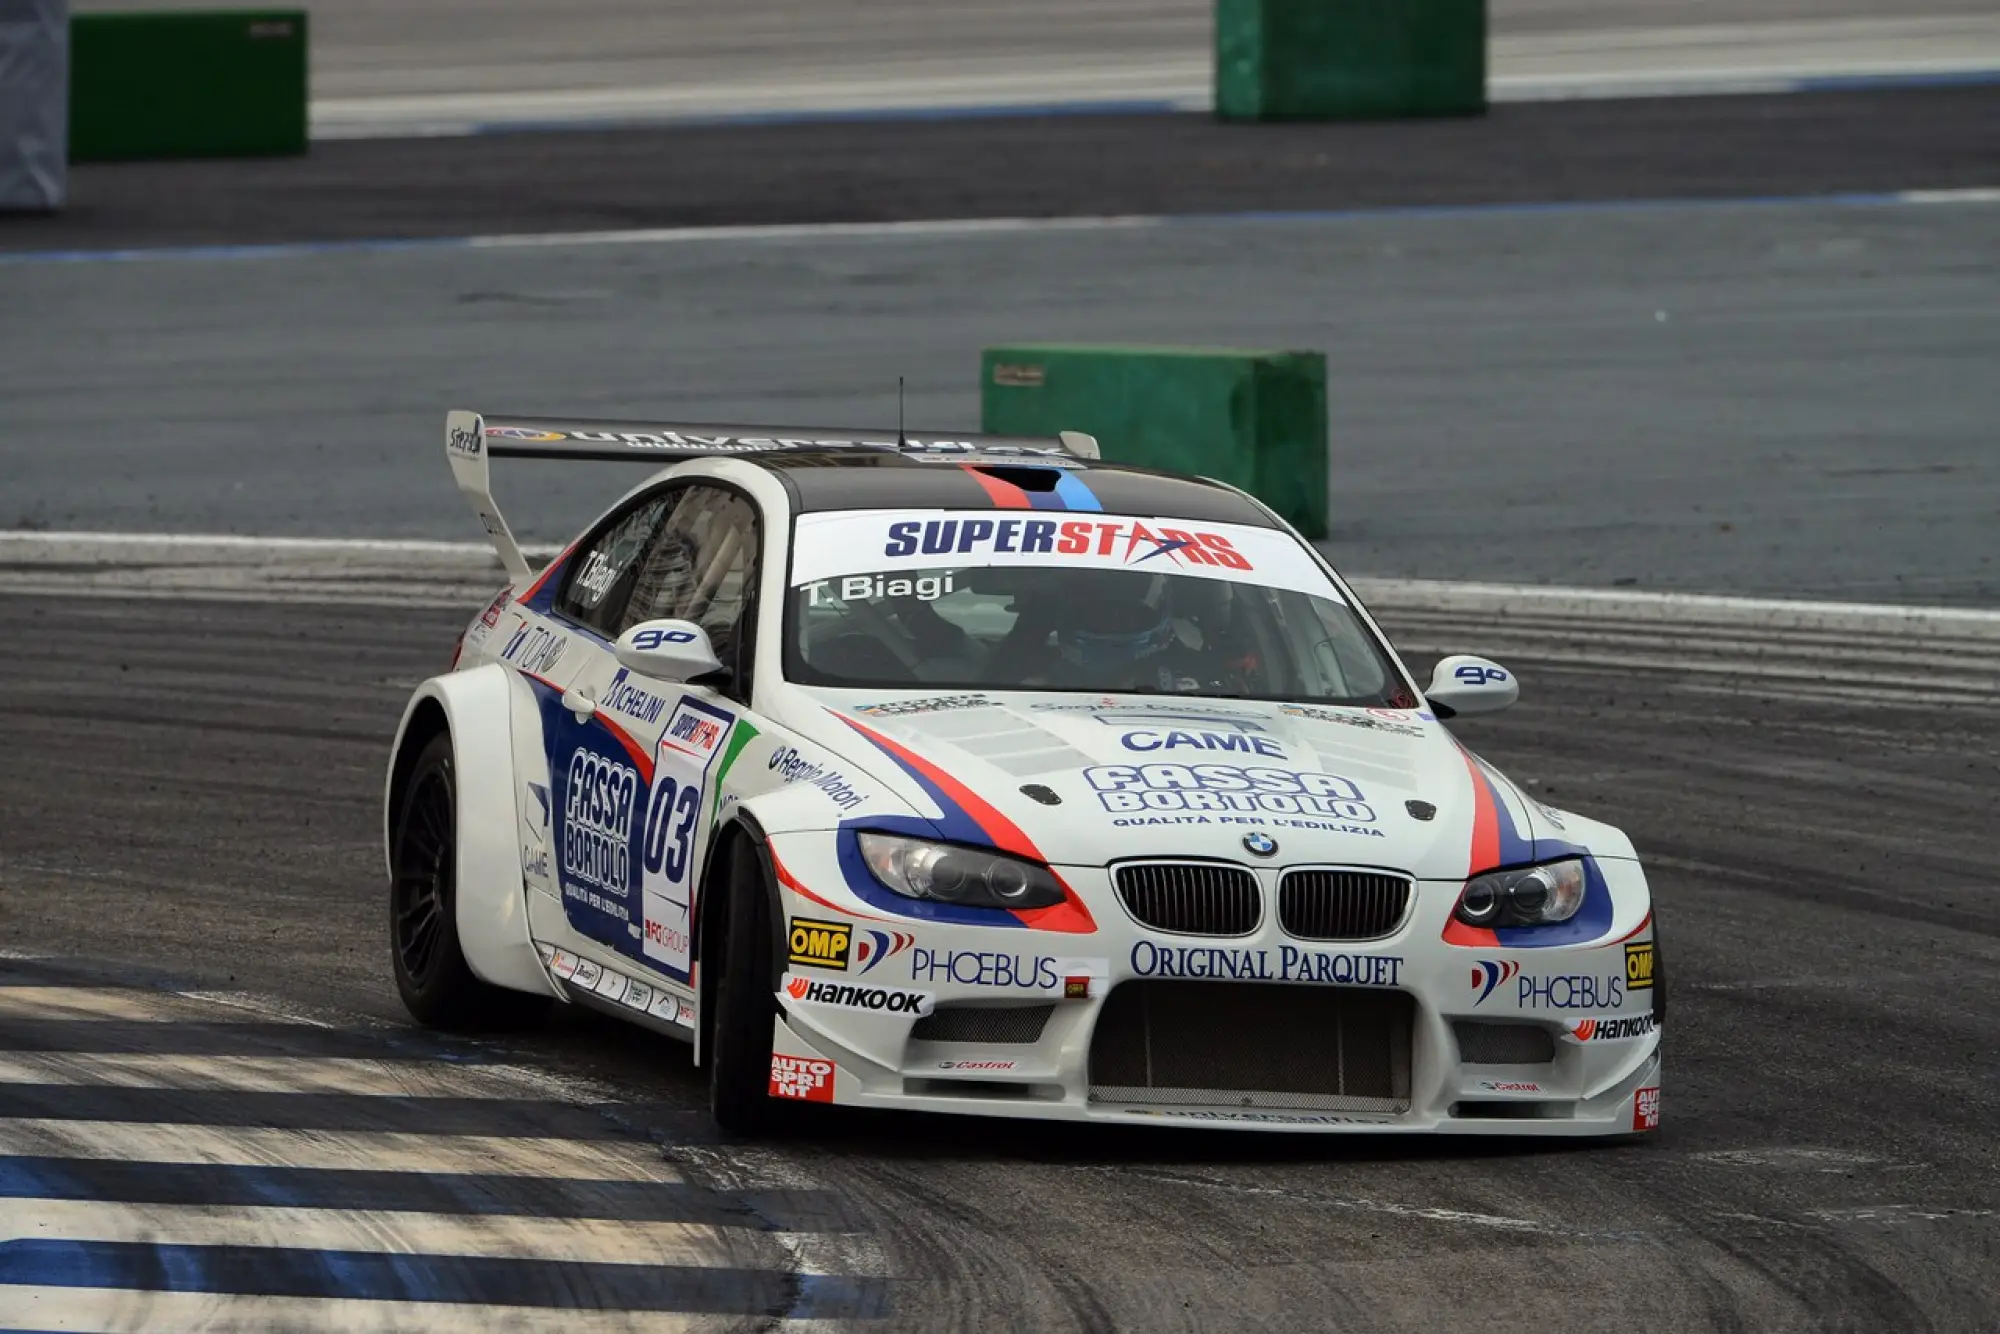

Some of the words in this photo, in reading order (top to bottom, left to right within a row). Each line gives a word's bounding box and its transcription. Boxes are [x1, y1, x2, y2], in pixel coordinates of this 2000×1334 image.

[884, 519, 1254, 571] SUPERSTARS
[842, 571, 953, 600] Biagi
[1121, 731, 1288, 760] CAME
[564, 746, 637, 843] FASSA
[1082, 763, 1365, 801] FASSA
[1097, 789, 1378, 823] BORTOLO
[644, 775, 700, 884] 03
[1220, 816, 1265, 826] PER
[1274, 819, 1386, 838] L'EDILIZIA
[564, 819, 631, 898] BORTOLO
[790, 928, 849, 959] OMP
[1130, 939, 1274, 980] ORIGINAL
[1278, 944, 1404, 986] PARQUET
[771, 1069, 824, 1088] SPRI
[772, 1055, 832, 1076] AUTO
[956, 1060, 1015, 1070] Castrol
[778, 1083, 810, 1098] NT
